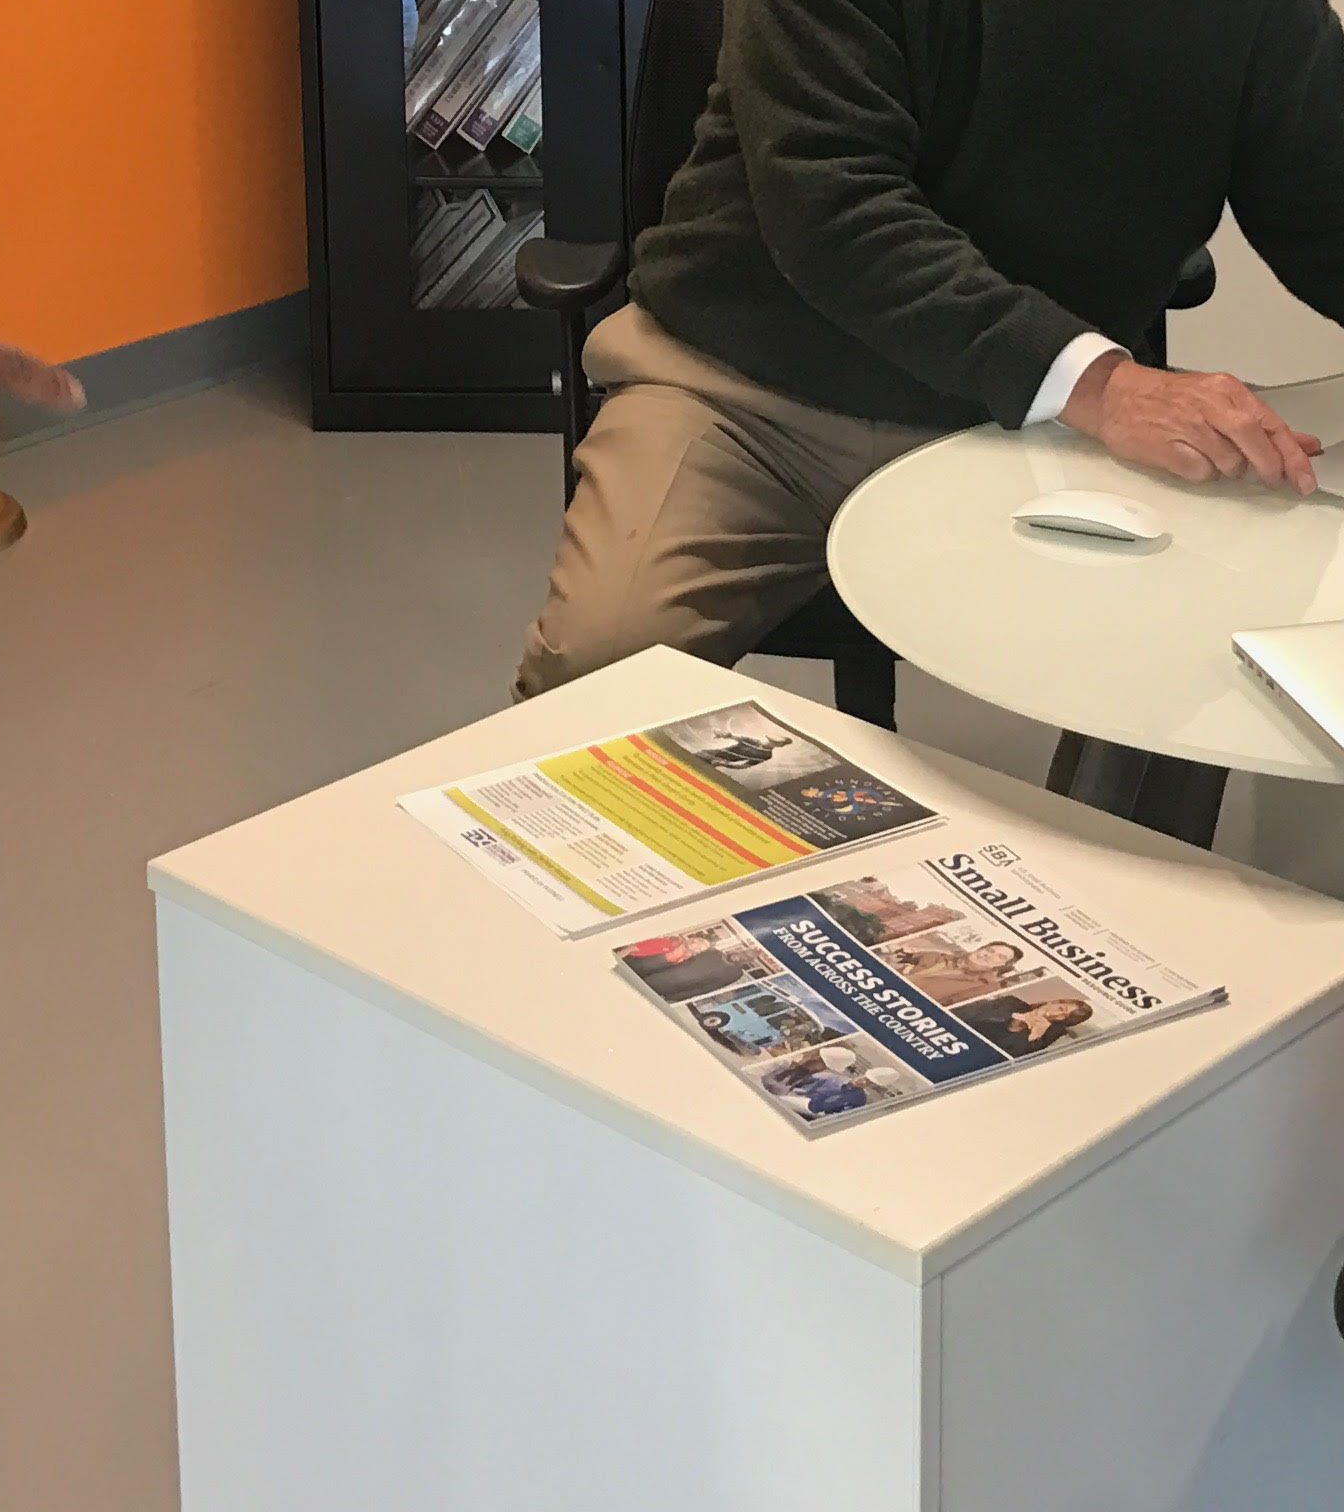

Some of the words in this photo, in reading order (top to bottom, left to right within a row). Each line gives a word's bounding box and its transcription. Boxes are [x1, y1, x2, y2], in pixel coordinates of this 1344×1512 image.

[982, 844, 1015, 867] SBA
[772, 927, 811, 962] FROM
[805, 955, 858, 995] ACROSS
[850, 992, 884, 1016] THE
[877, 1012, 945, 1061] COUNTRY
[790, 919, 884, 990] SUCCESS
[873, 988, 969, 1056] STORIES
[938, 853, 1037, 919] Small
[1019, 917, 1162, 1009] Business
